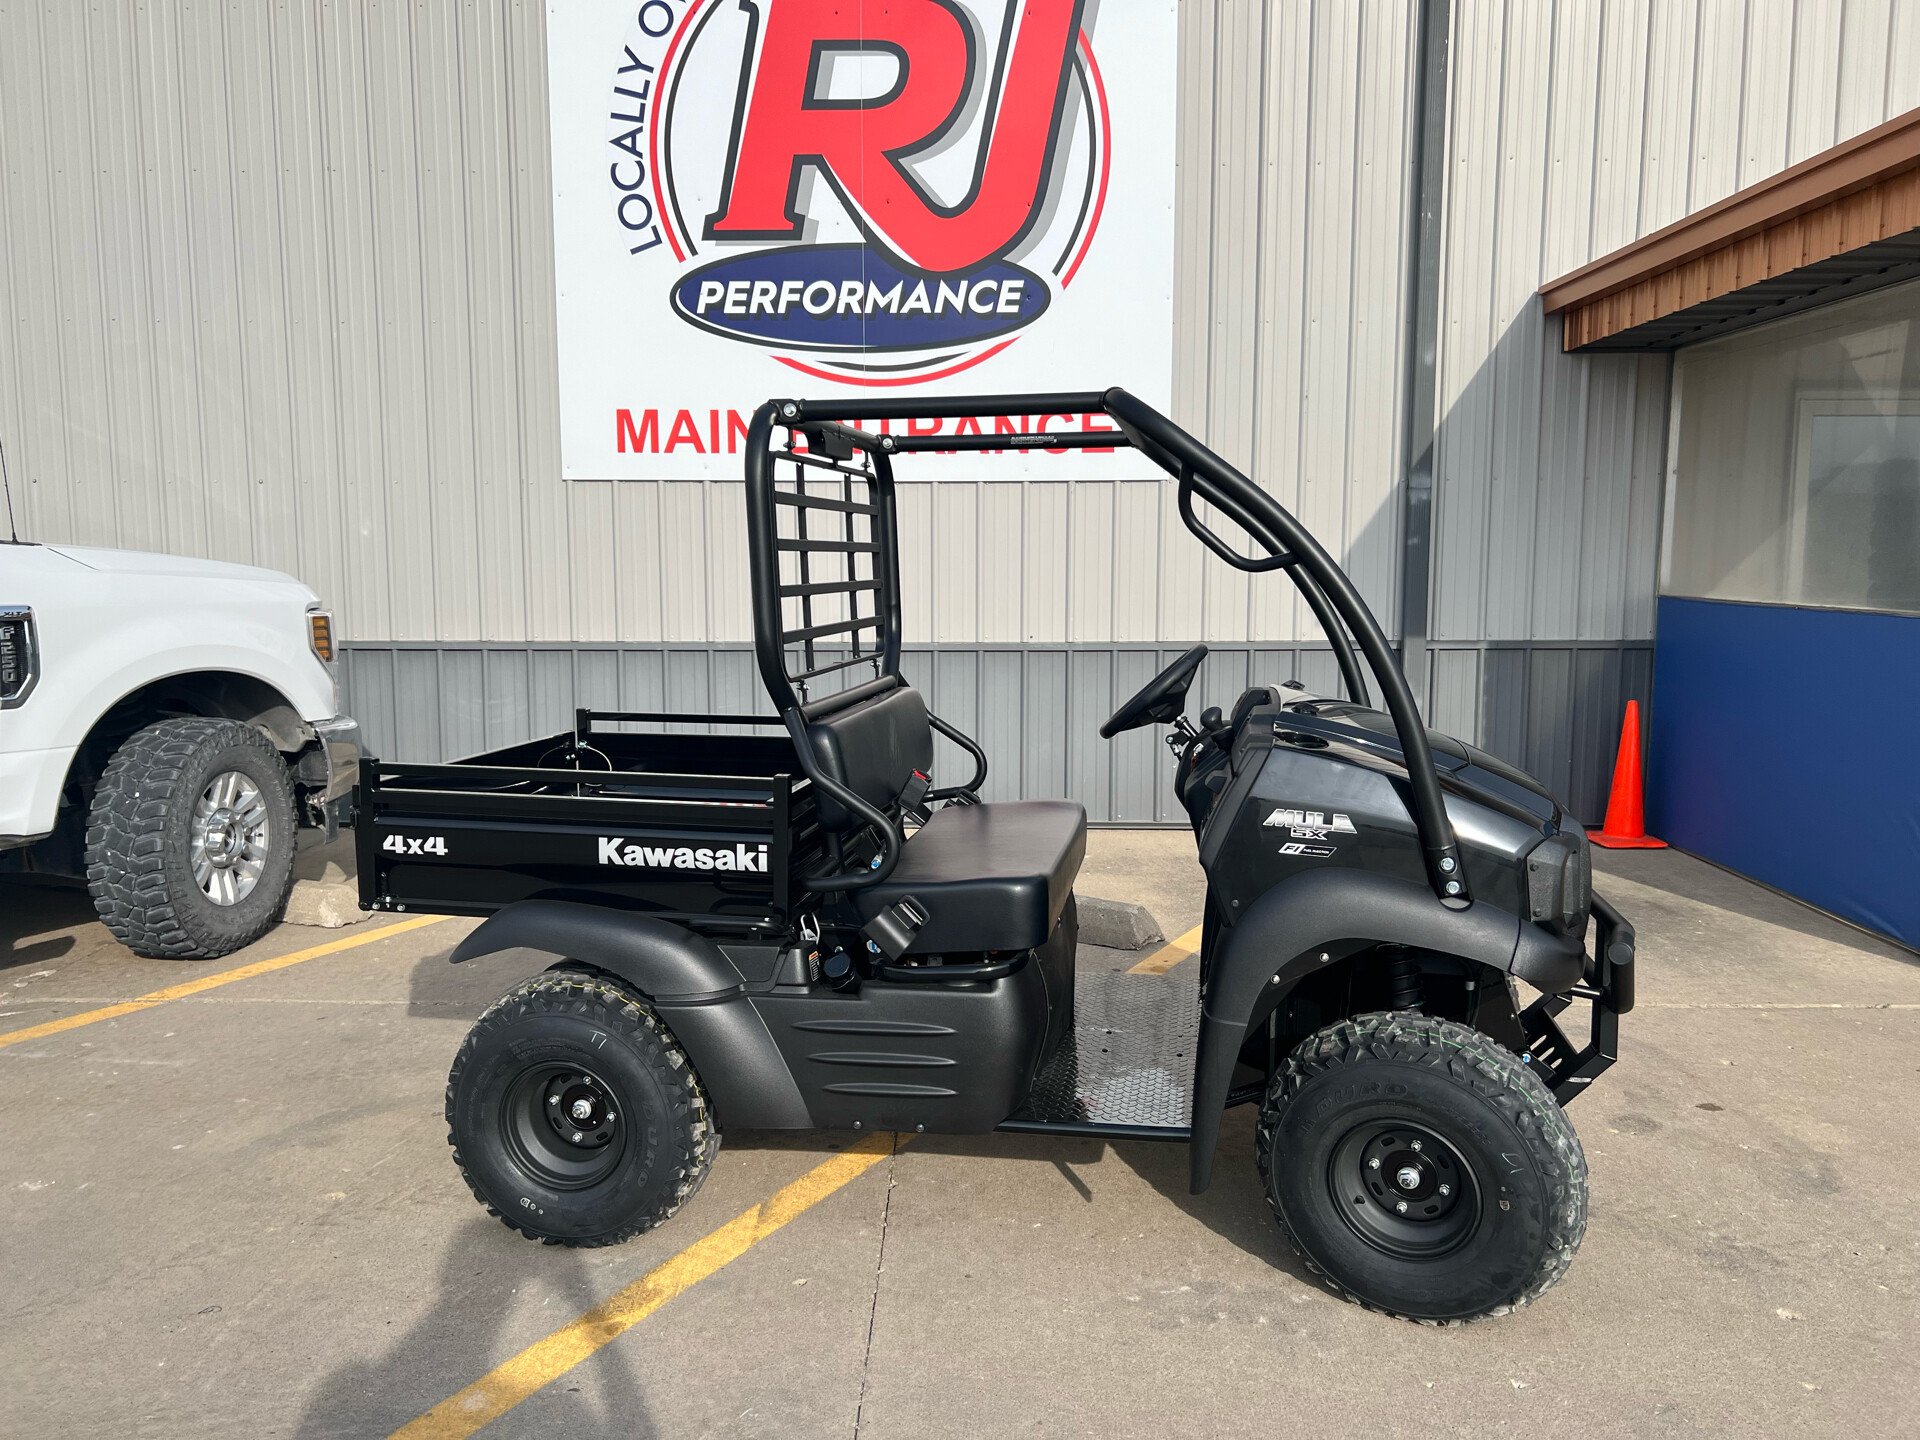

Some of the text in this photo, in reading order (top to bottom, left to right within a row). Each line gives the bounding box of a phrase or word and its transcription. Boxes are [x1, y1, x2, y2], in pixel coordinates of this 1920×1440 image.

[608, 0, 687, 255] LOCALLY O
[702, 0, 1085, 272] RJ
[696, 279, 1025, 315] PERFORMANCE
[616, 408, 1116, 455] MAIN RANCE
[1262, 808, 1358, 835] MULE
[1290, 827, 1328, 841] SX
[382, 834, 449, 856] 4x4
[598, 837, 769, 873] Kawasaki
[1283, 844, 1301, 852] FI
